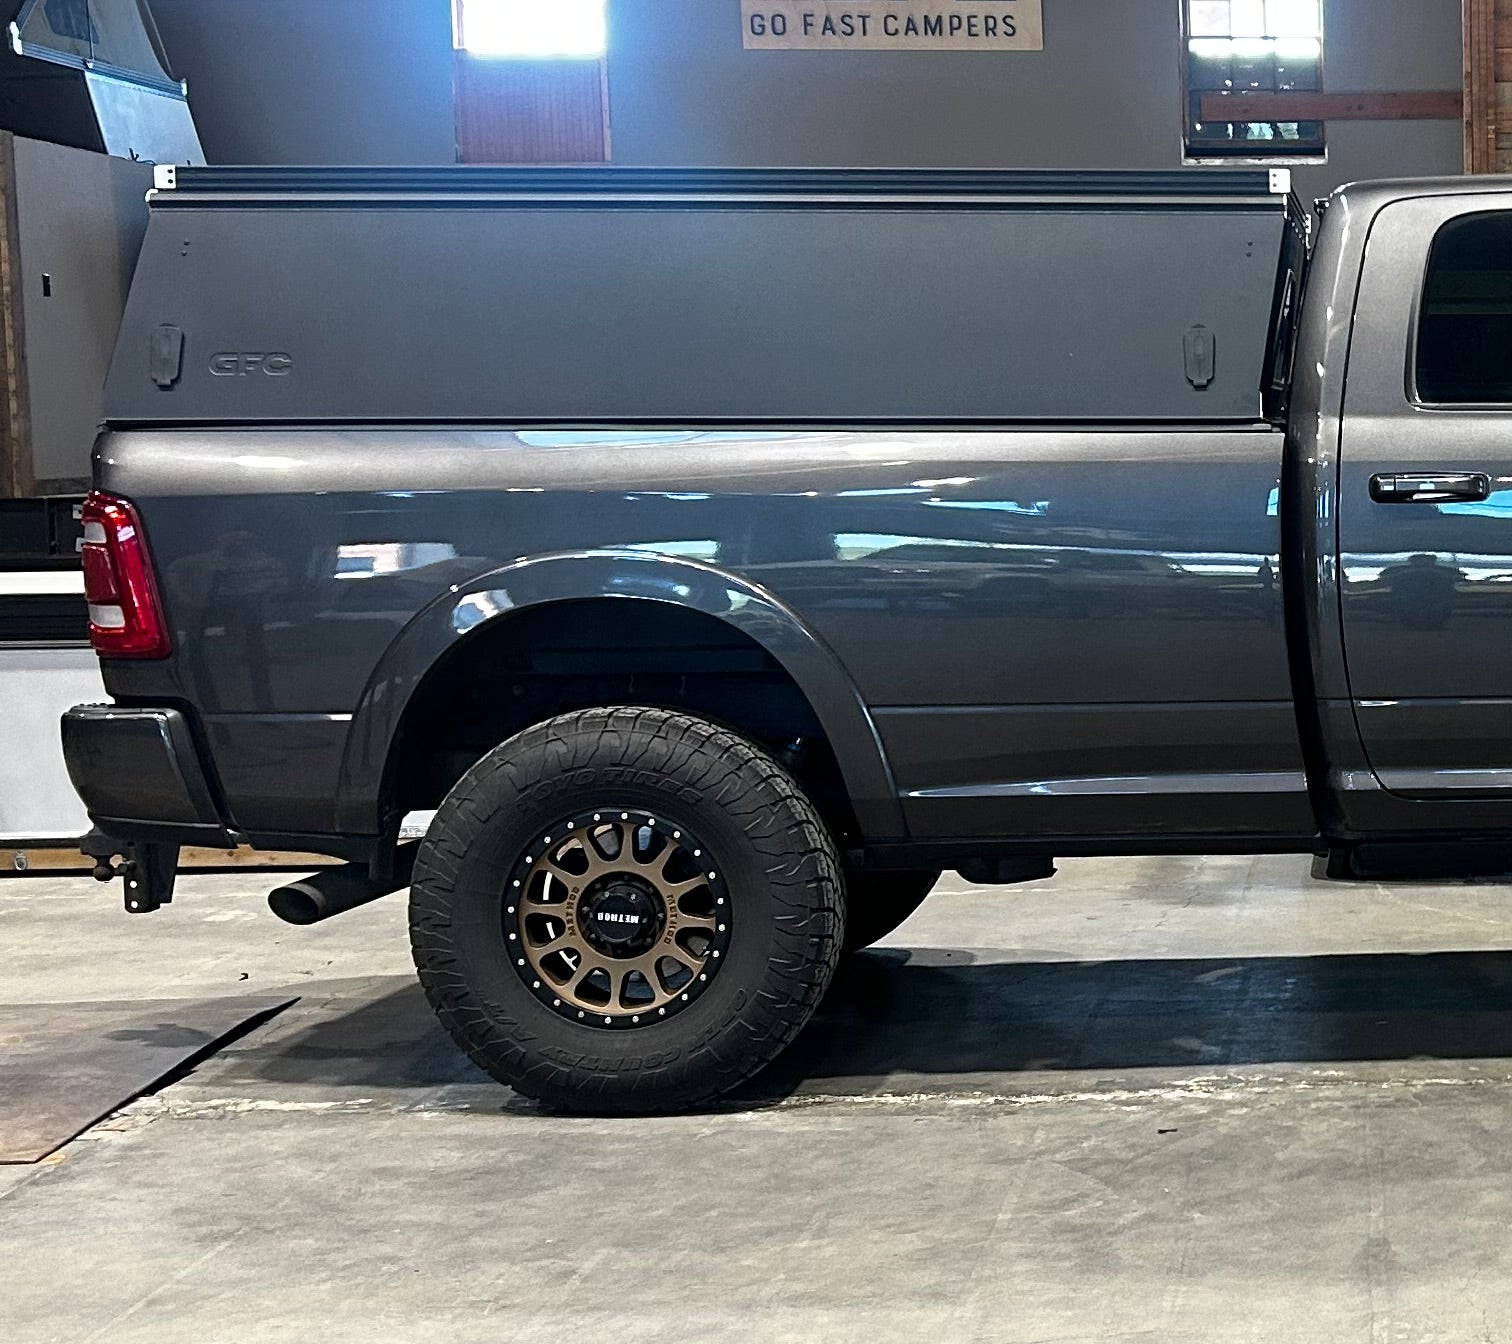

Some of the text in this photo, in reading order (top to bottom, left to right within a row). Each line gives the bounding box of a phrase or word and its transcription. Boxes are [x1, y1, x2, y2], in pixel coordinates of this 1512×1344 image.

[750, 13, 1017, 38] GO FAST CAMPERS
[207, 351, 293, 376] GFC
[564, 885, 581, 937] METHOD
[597, 911, 640, 924] METHOD
[665, 893, 679, 946] METHOD
